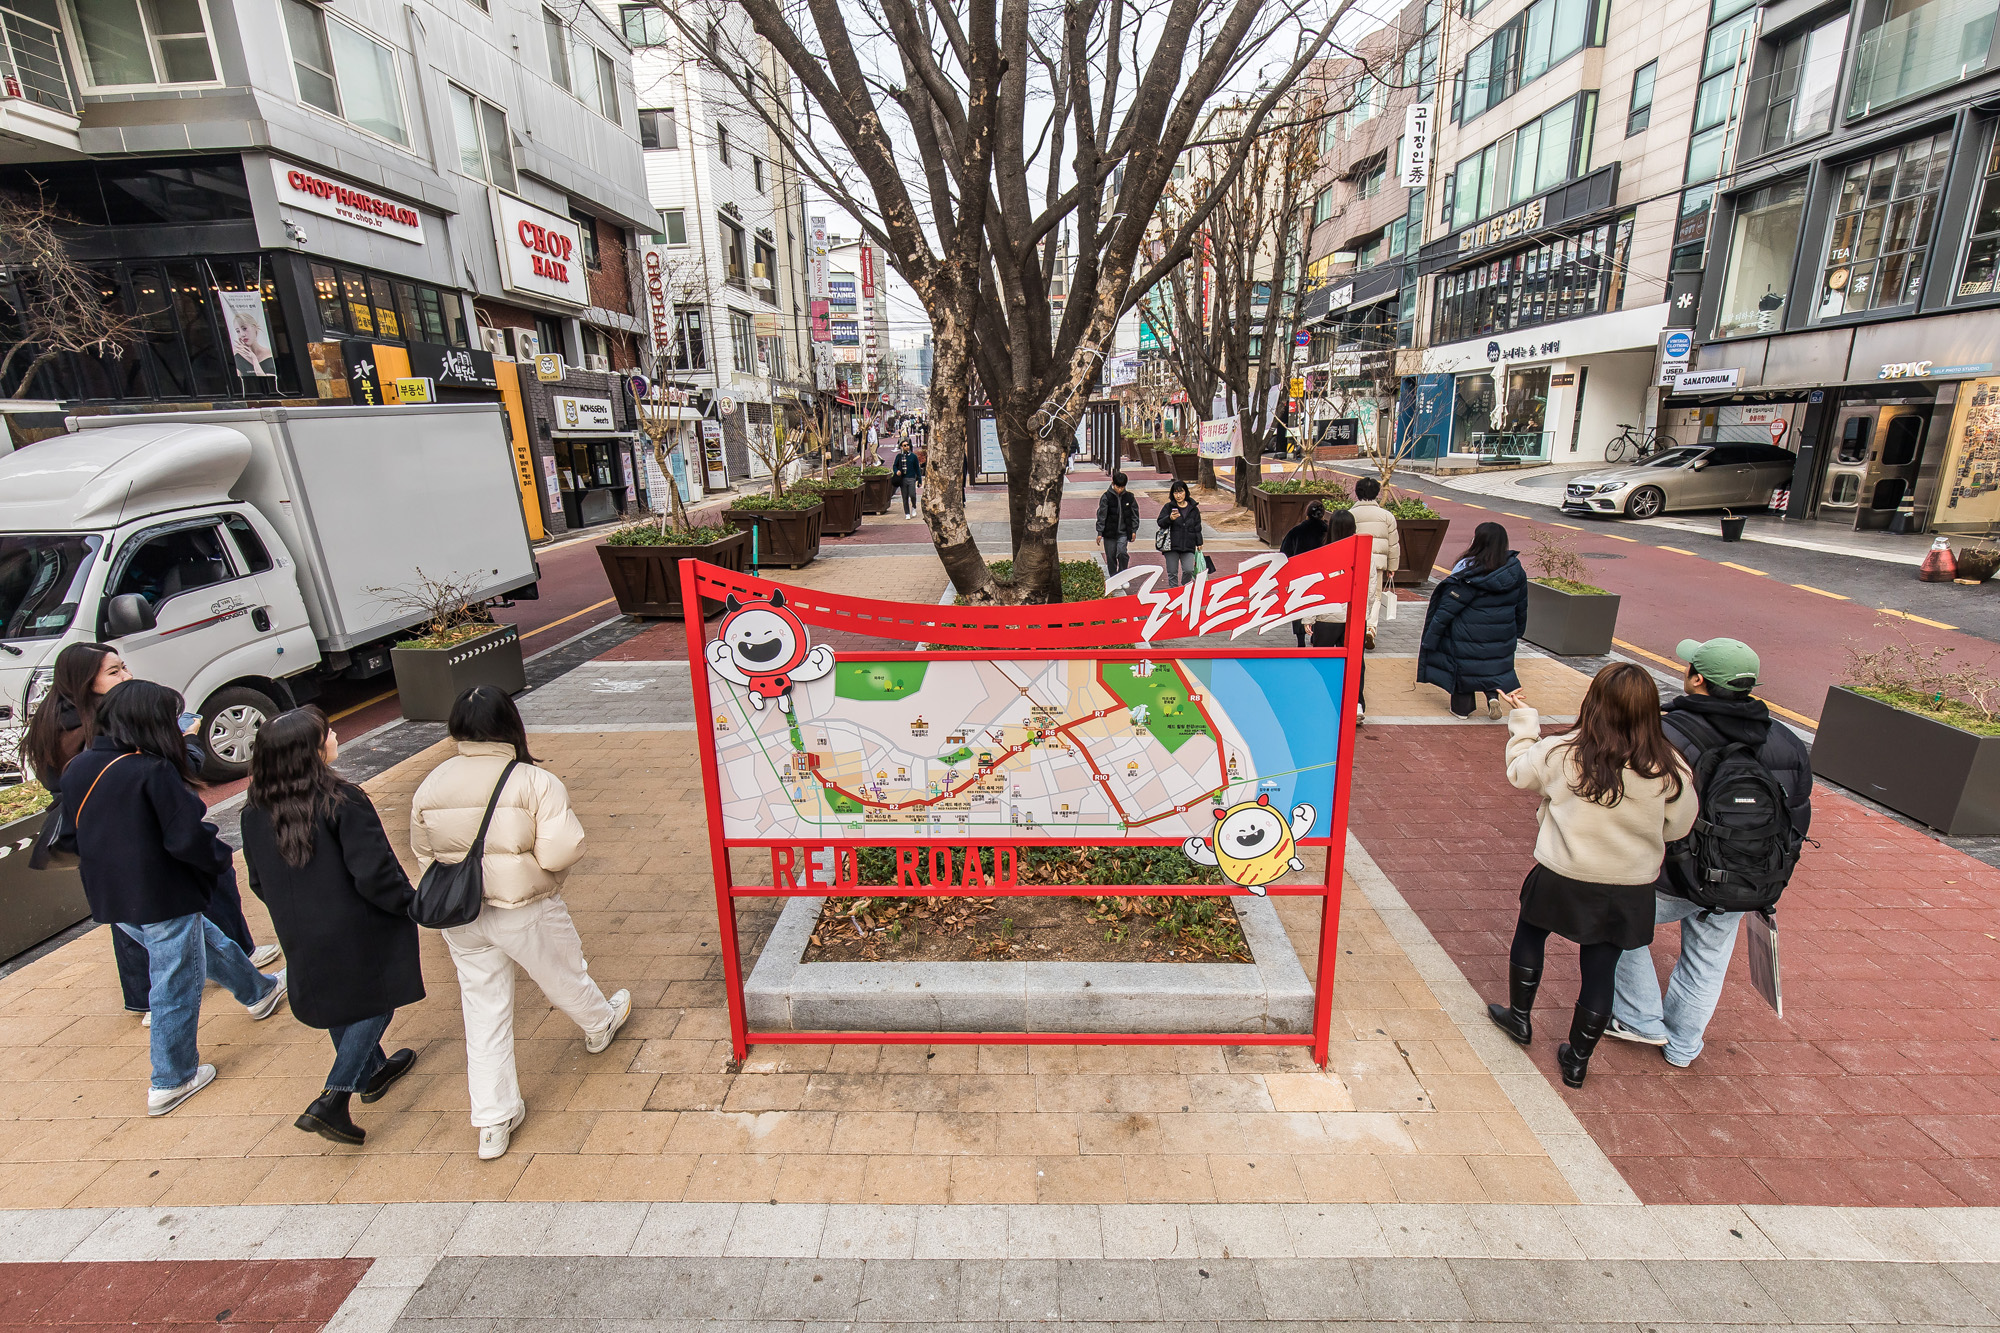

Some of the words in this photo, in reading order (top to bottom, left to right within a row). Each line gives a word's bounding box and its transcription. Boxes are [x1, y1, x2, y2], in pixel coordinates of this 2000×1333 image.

[1409, 108, 1427, 183] 고기장인秀
[336, 206, 382, 228] www.chop.kr
[518, 220, 572, 260] CHOP
[1832, 248, 1850, 260] TEA
[531, 254, 570, 284] HAIR
[1854, 276, 1869, 292] 茶
[400, 384, 424, 396] 부동산
[1683, 375, 1729, 386] SANATORIUM
[1325, 424, 1350, 440] 廣場
[1104, 552, 1343, 642] 레드로드
[771, 846, 858, 889] RED
[896, 846, 1018, 889] ROAD
